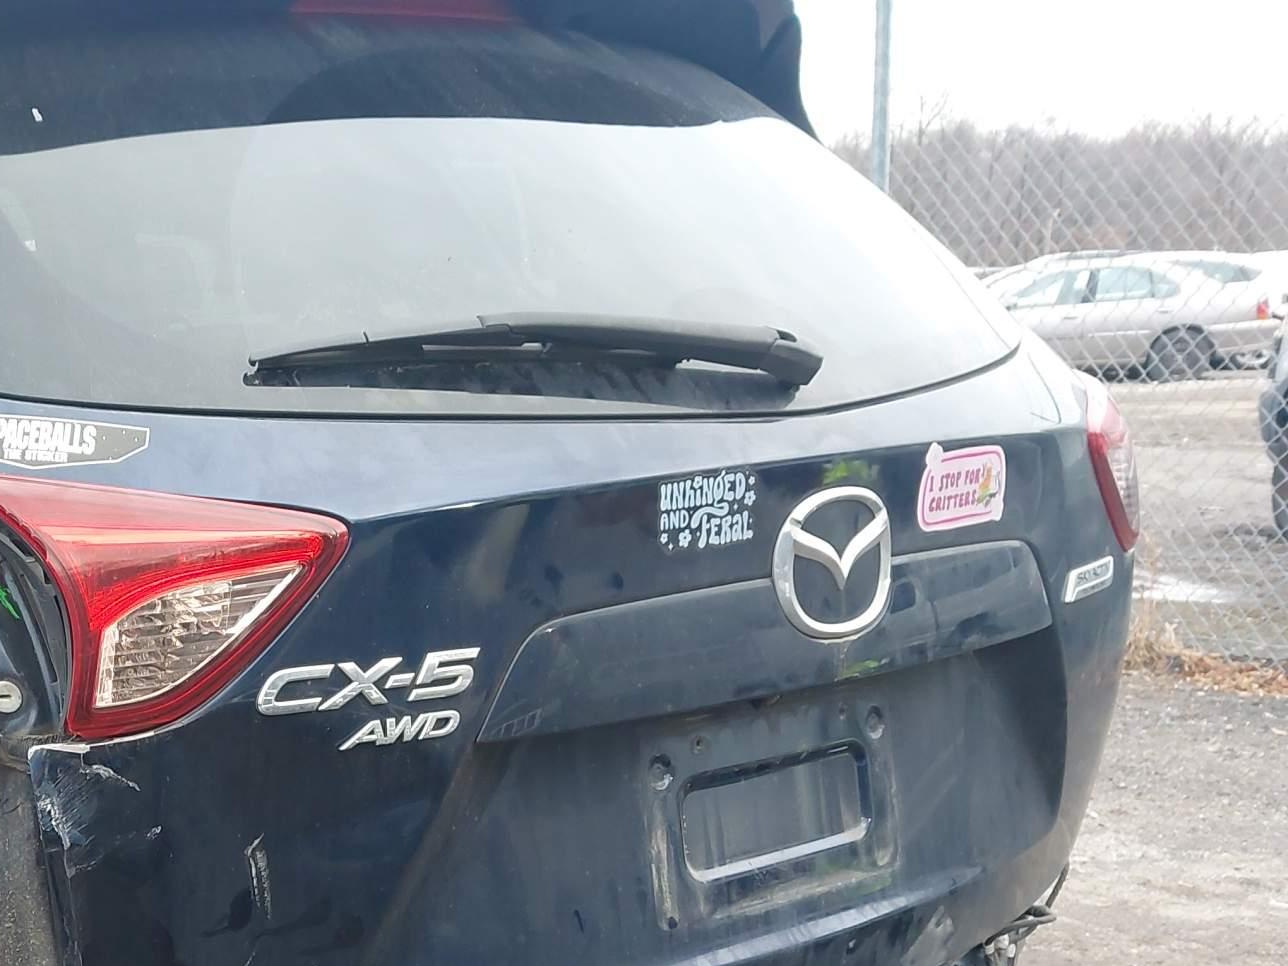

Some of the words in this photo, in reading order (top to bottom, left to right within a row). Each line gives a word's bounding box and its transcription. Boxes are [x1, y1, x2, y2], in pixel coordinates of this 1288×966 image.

[3, 448, 23, 460] THE
[929, 475, 934, 493] I
[938, 471, 962, 492] STOP
[964, 467, 981, 486] FOR
[928, 490, 978, 512] CRITTERS
[660, 509, 690, 530] AND
[256, 647, 481, 716] CX-5
[336, 710, 461, 751] AWD
